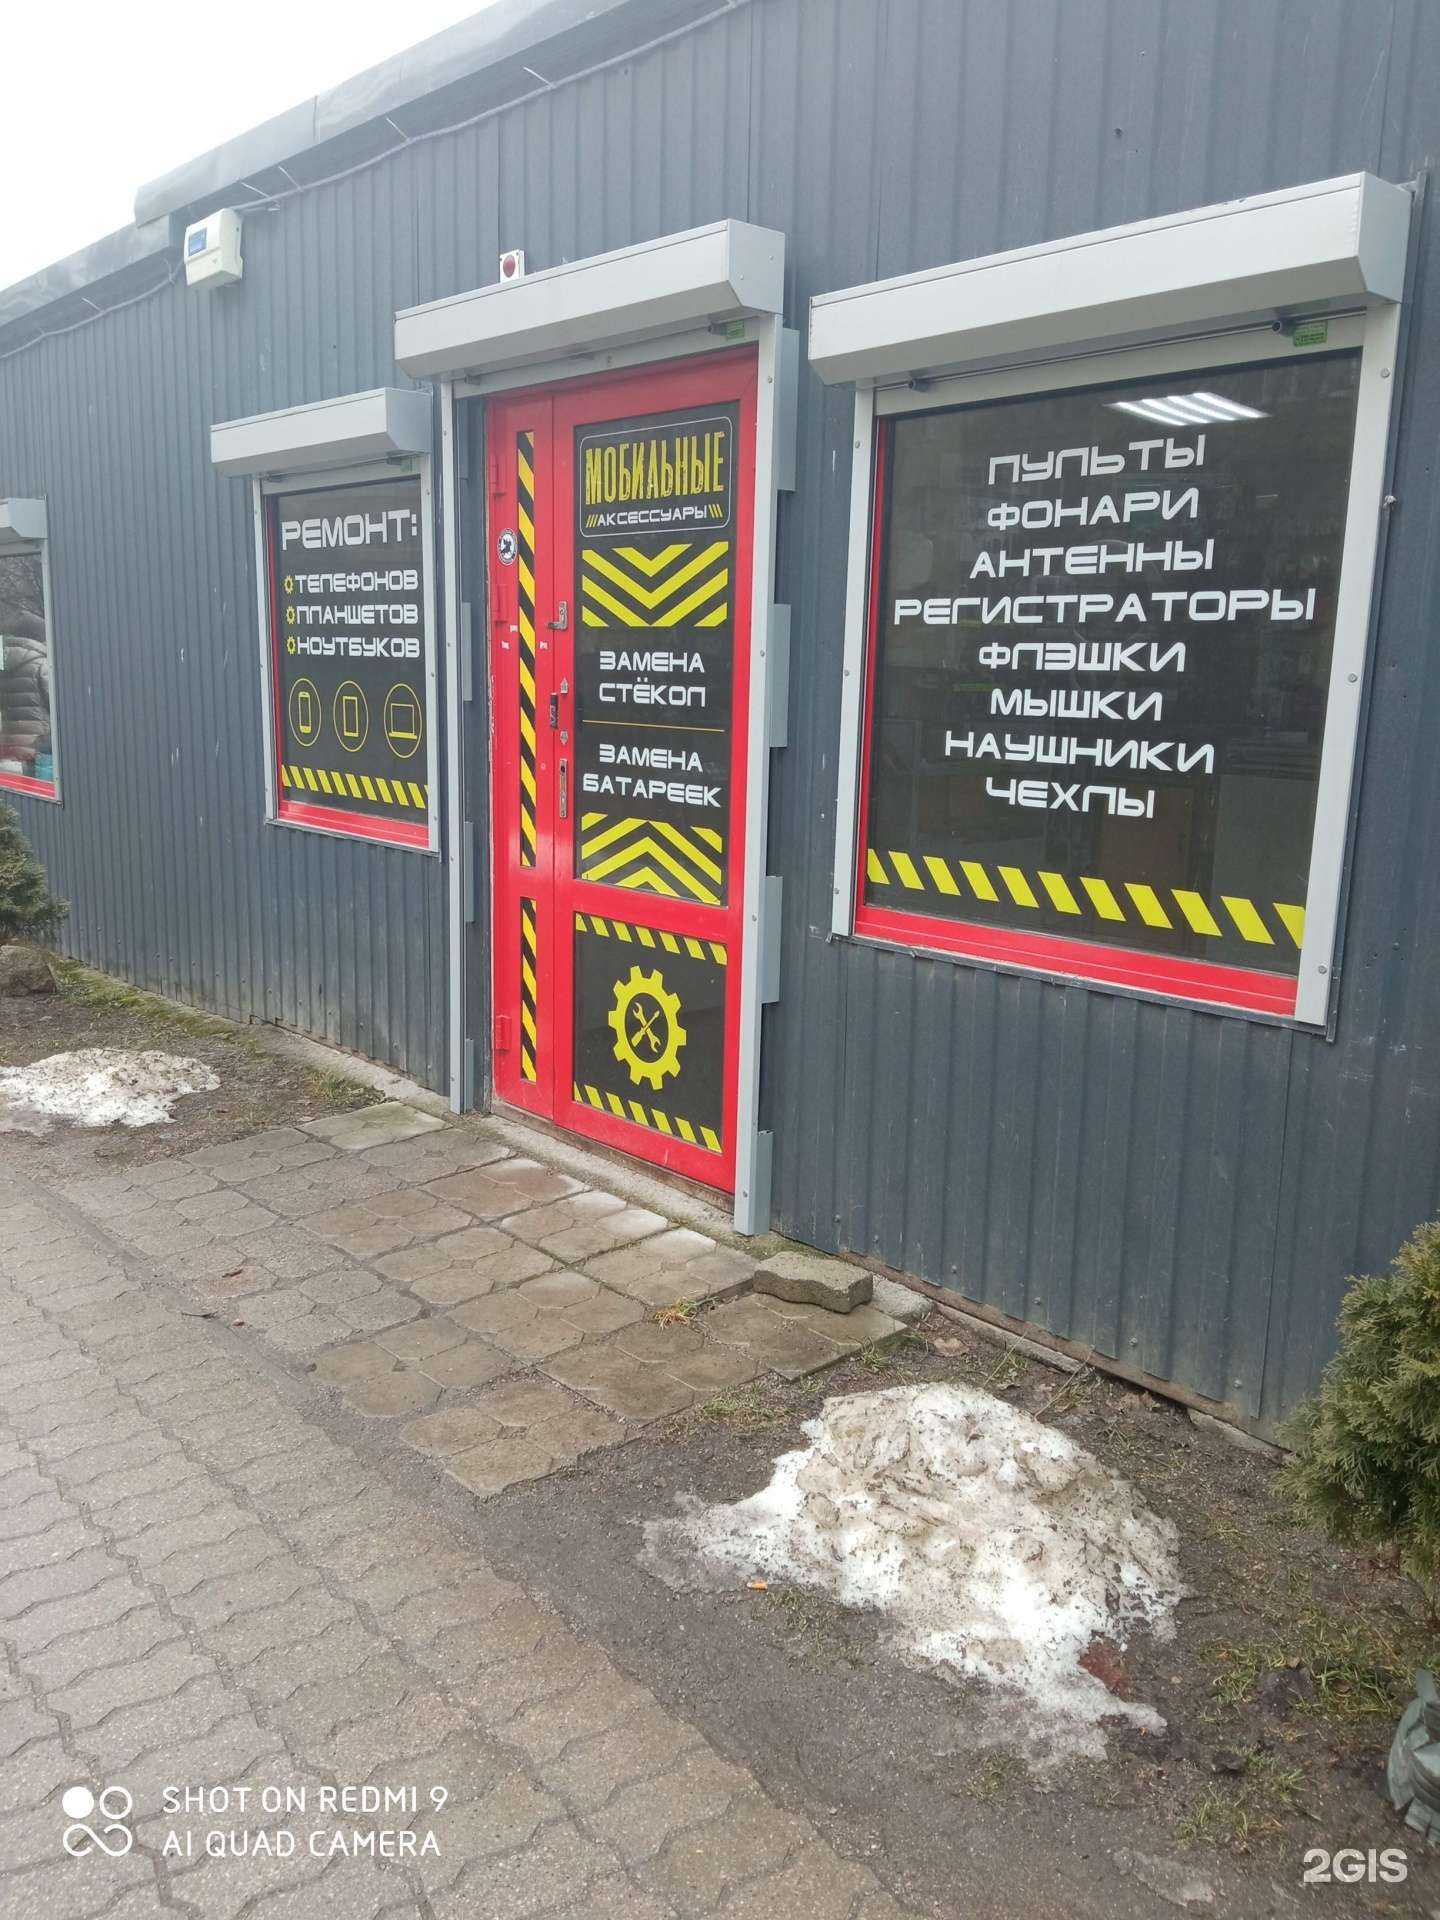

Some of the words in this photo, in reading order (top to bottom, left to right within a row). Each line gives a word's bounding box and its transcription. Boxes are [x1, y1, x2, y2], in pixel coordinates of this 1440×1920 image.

[585, 431, 726, 506] МОБИЛЬНЫЕ
[987, 434, 1206, 486] ПУЛЬТЫ
[986, 487, 1199, 532] ФОНАРИ
[280, 508, 419, 551] РЕМОНТ:
[968, 539, 1215, 580] АНТЕННЫ
[295, 569, 419, 594] ТЕЛЕФОНОВ
[296, 603, 419, 626] ПЛАНШЕТОВ
[893, 588, 1317, 626] РЕГИСТРАТОРЫ
[296, 636, 421, 659] НОУТБУКОВ
[599, 650, 705, 673] ЗАМЕНА
[978, 641, 1186, 673] ФЛЭШКИ
[598, 676, 706, 708] СТЁКОЛ
[989, 687, 1163, 722] МЫШКИ
[599, 743, 704, 773] ЗАМЕНА
[944, 729, 1215, 775] НАУШНИКИ
[582, 772, 722, 808] БАТАРЕЕК
[985, 776, 1155, 819] ЧЕХЛЫ
